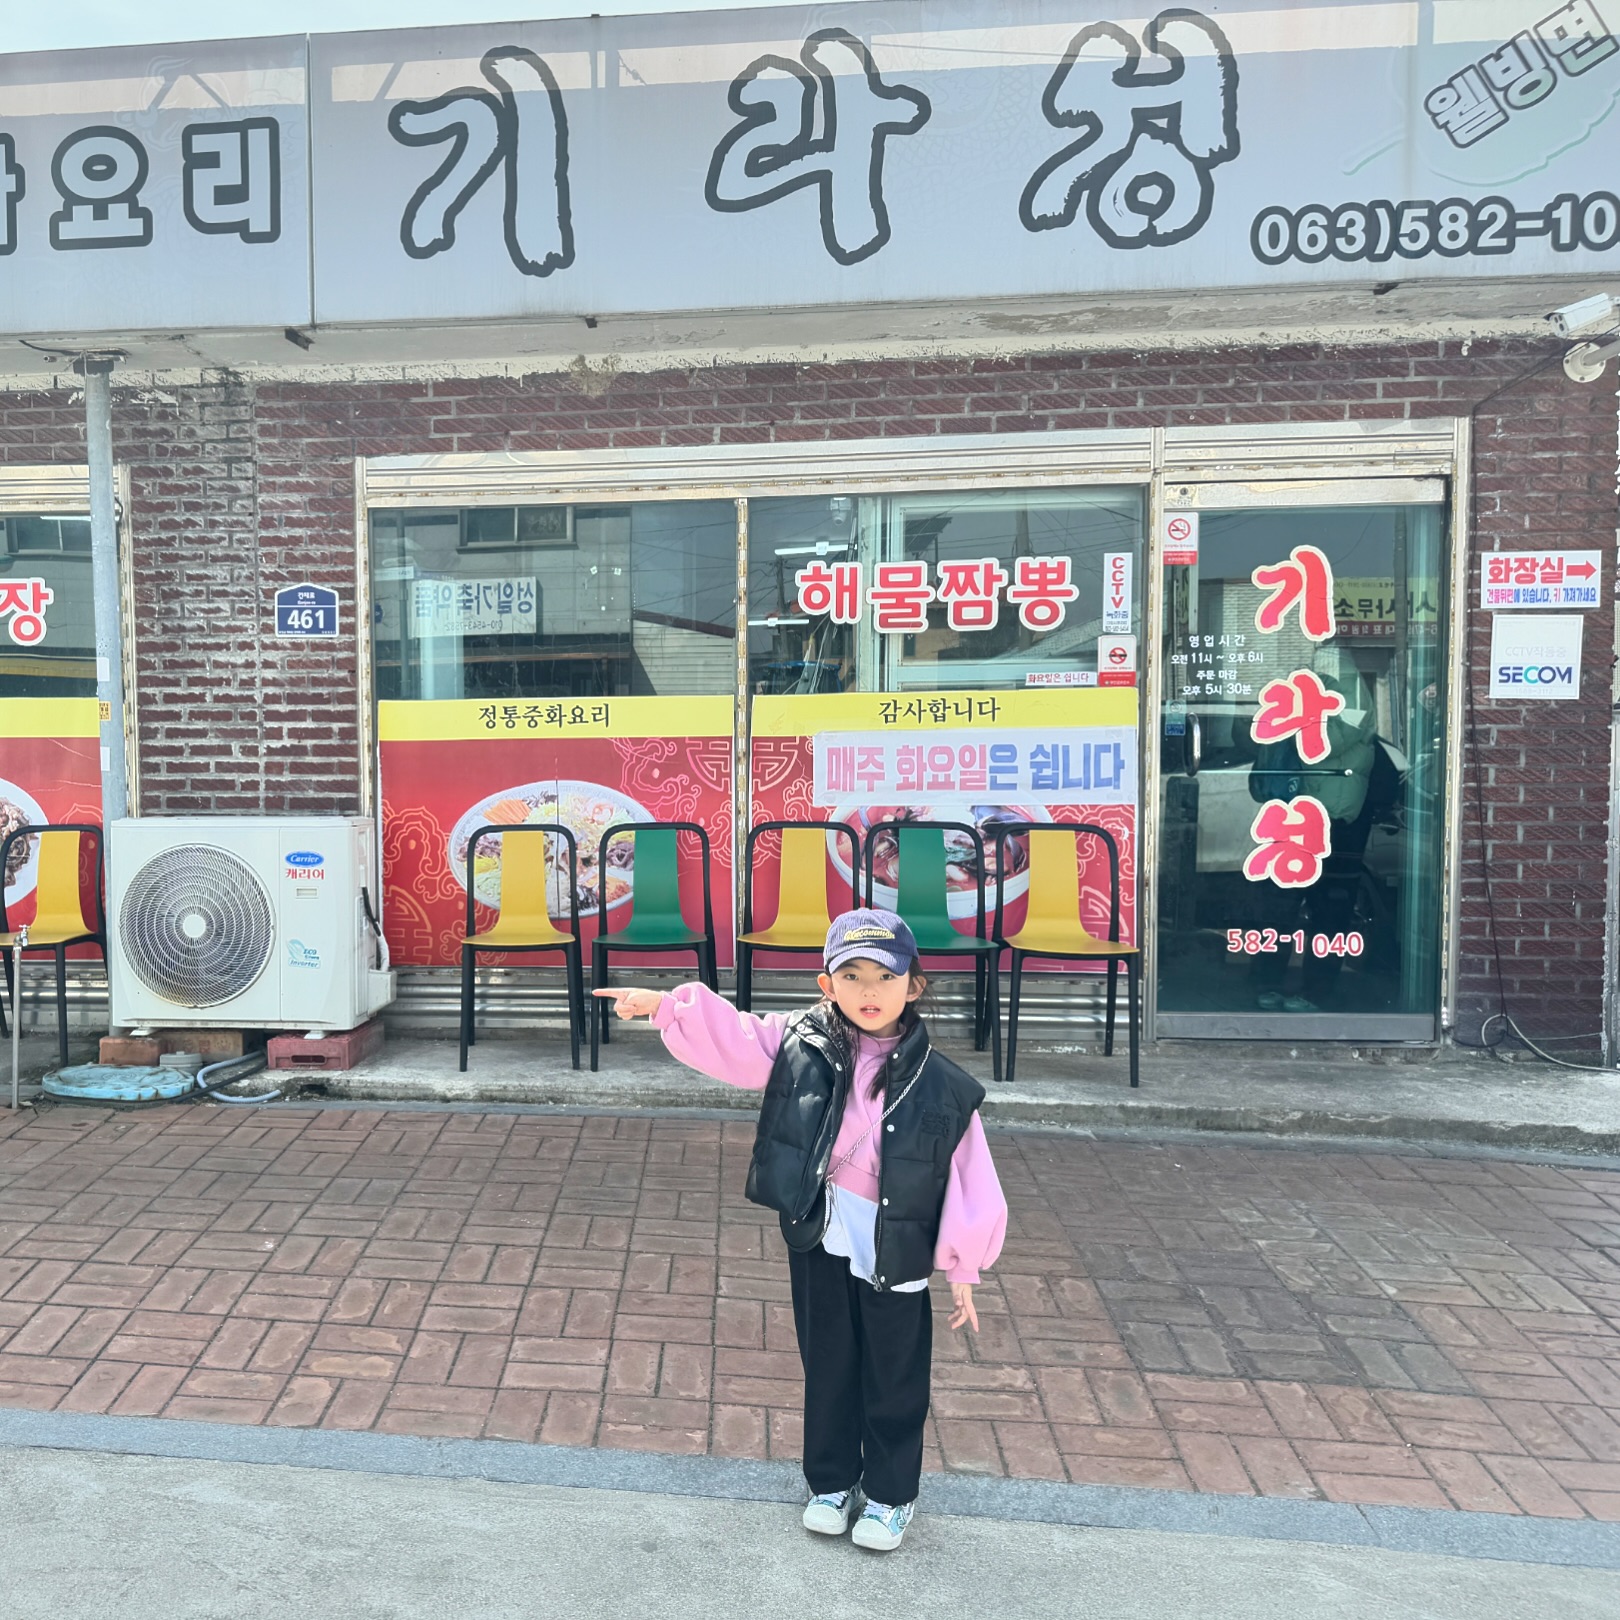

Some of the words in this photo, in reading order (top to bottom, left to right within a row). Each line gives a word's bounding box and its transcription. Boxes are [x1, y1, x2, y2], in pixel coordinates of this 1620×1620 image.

[1424, 0, 1620, 148] 웰빙면
[387, 8, 1241, 278] 기라성
[1111, 556, 1125, 609] CCTV
[1487, 556, 1564, 585] 화장실
[795, 556, 1080, 634] 해물짬뽕
[1486, 588, 1520, 604] 건물뒤편에
[1553, 587, 1561, 603] 키
[1562, 587, 1597, 603] 가져가세요
[0, 577, 54, 647] 장
[287, 609, 325, 629] 461
[1171, 654, 1188, 664] 오전
[1191, 652, 1212, 664] 11시
[1228, 653, 1246, 663] 오후
[1247, 650, 1263, 663] 6시
[1028, 673, 1061, 684] 화요일은
[1063, 672, 1089, 683] 쉽니다
[1196, 670, 1215, 680] 주문
[1218, 669, 1238, 680] 마감
[1498, 665, 1573, 684] SECOM
[1182, 685, 1201, 695] 오후
[1205, 683, 1222, 695] 5시
[1226, 682, 1252, 695] 30분
[478, 703, 611, 729] 정통중화요리
[878, 696, 1001, 724] 감사합니다
[1242, 545, 1345, 889] 기라성
[826, 744, 885, 792] 매주
[896, 744, 1018, 792] 화요일은
[1029, 742, 1125, 791] 쉽니다
[290, 853, 320, 863] Carrier
[285, 868, 325, 880] 캐리어
